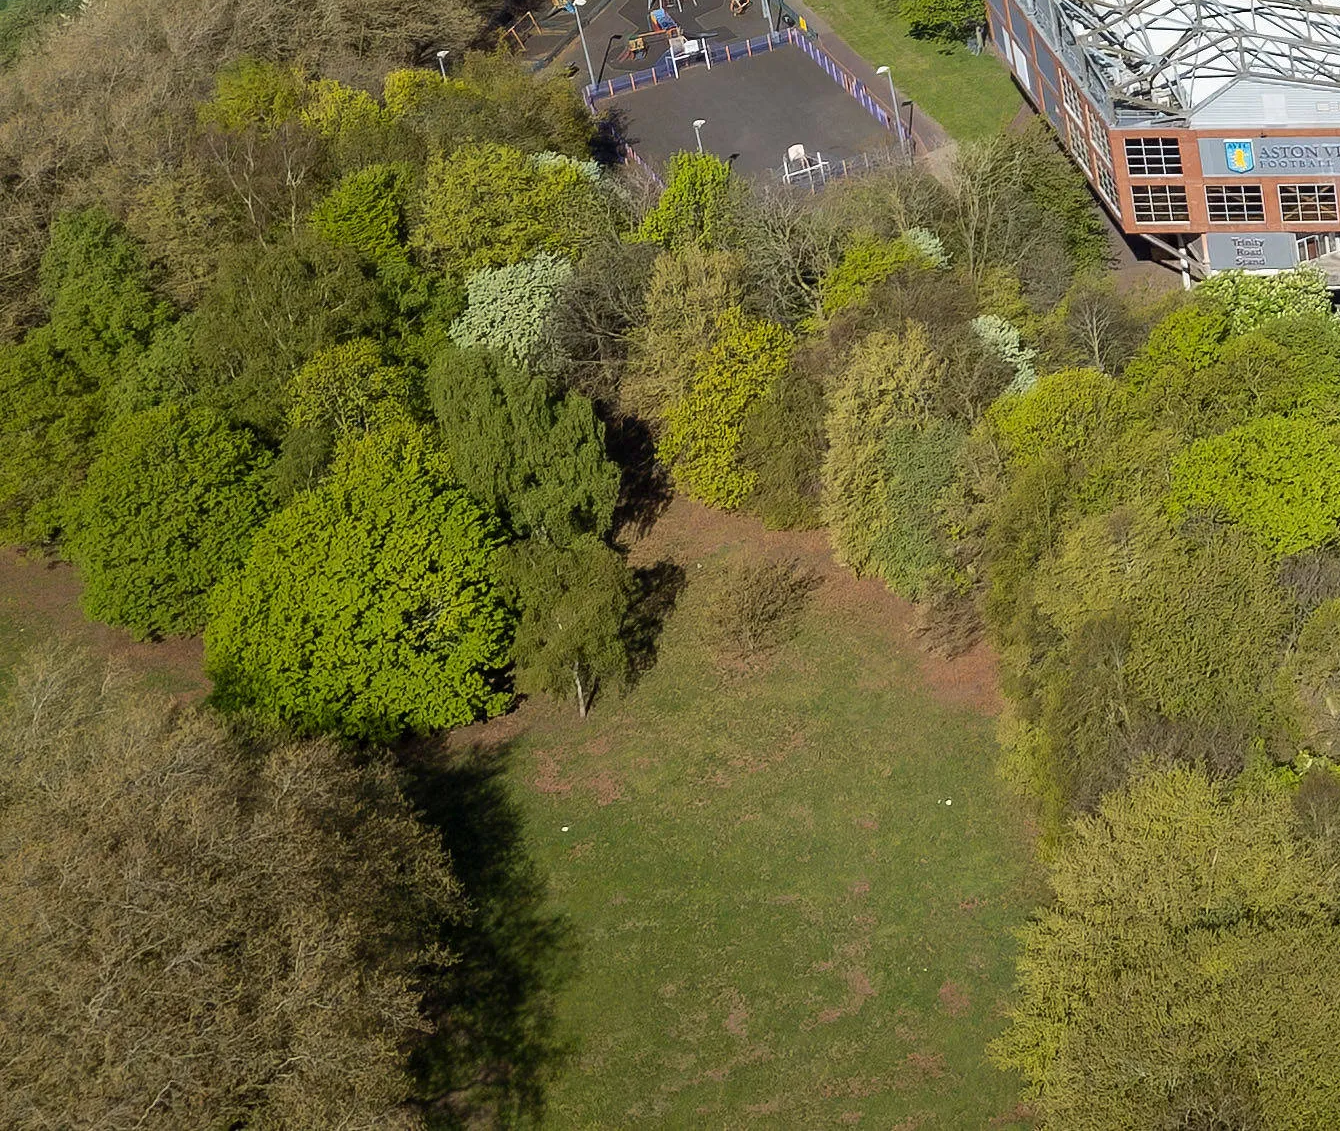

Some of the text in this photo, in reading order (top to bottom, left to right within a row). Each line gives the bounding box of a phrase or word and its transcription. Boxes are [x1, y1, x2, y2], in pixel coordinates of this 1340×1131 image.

[1259, 145, 1318, 159] ASTON
[1259, 159, 1334, 169] FOOTBALL
[1231, 237, 1265, 247] Trinity
[1236, 248, 1263, 256] Road
[1235, 257, 1266, 266] Stand
